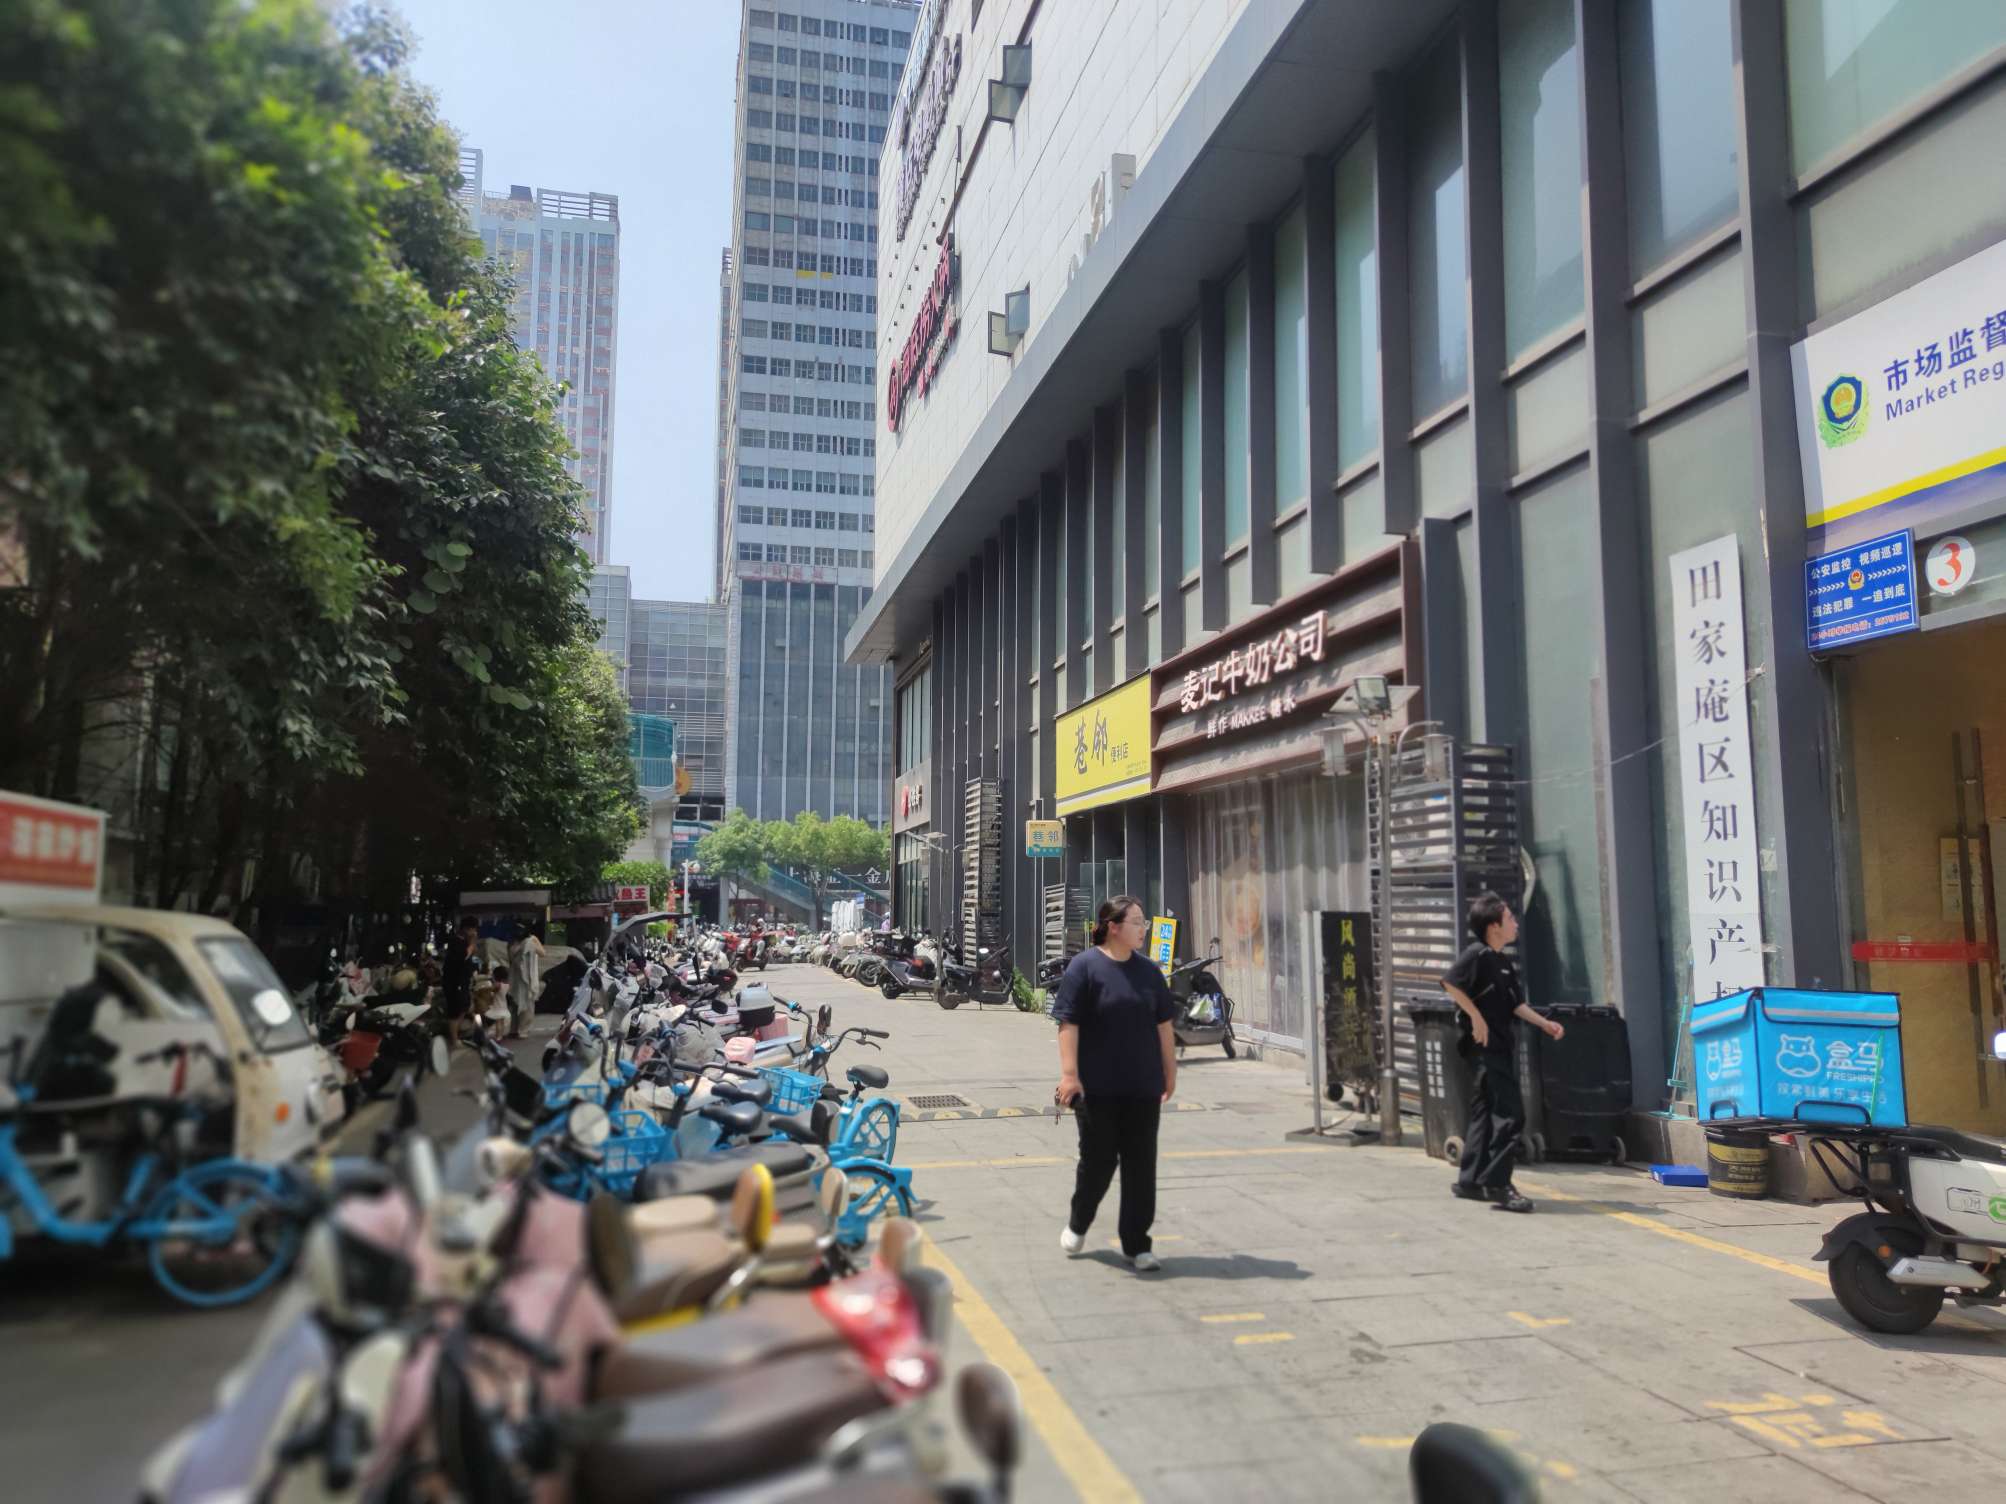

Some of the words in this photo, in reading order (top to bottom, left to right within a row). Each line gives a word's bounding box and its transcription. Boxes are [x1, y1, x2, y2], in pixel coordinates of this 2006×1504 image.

[1882, 309, 2006, 393] 市场监督
[1885, 377, 1958, 421] Market
[1811, 556, 1852, 580] 公安监控
[1938, 542, 1962, 587] 3
[1180, 609, 1329, 714] 麦记牛奶公司
[1825, 1040, 1884, 1072] 盒马
